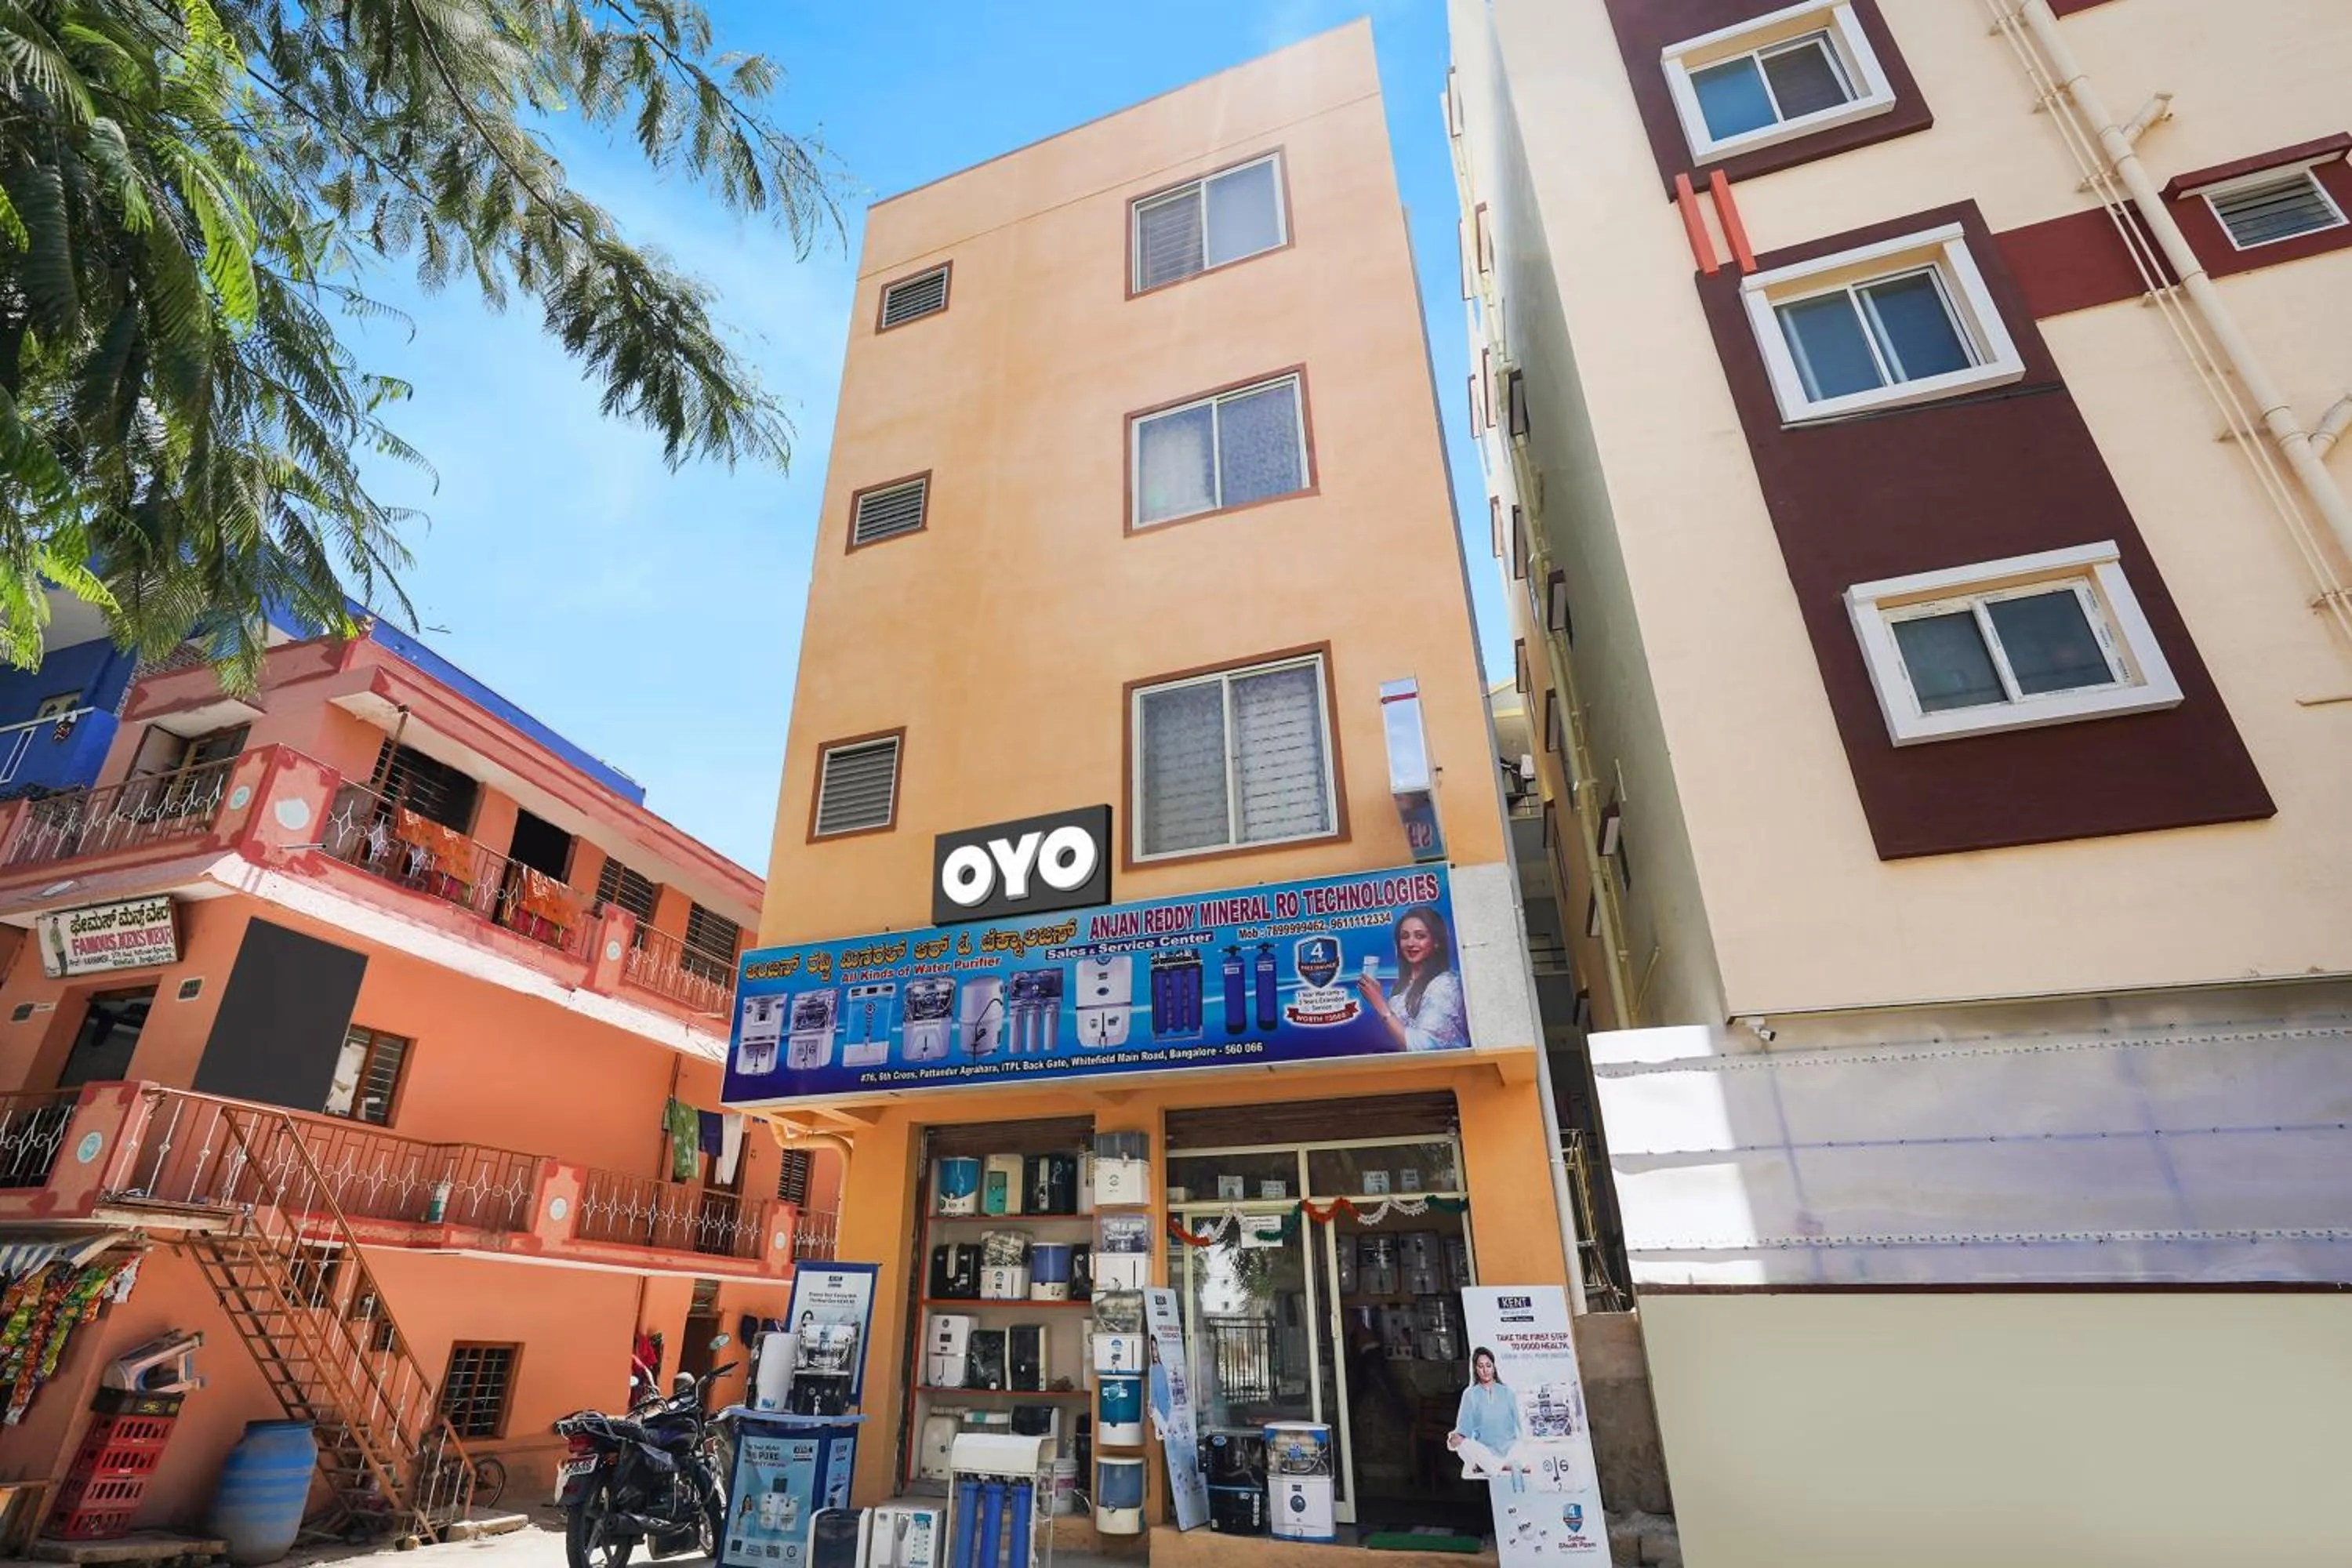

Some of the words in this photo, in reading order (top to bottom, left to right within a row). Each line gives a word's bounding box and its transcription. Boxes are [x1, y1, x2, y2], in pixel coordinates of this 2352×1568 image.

[942, 826, 1098, 907] OYO
[1089, 912, 1140, 941] ANJAN
[1145, 903, 1196, 933] REDDY
[1200, 895, 1271, 927] MINERAL
[1276, 891, 1298, 917] RO
[1303, 874, 1439, 915] TECHNOLOGIES
[71, 932, 117, 956] FAMOUS
[146, 926, 173, 946] WEAR
[1047, 946, 1087, 959] Sales
[1098, 940, 1155, 953] Service
[1160, 932, 1211, 946] Center
[1239, 928, 1258, 939] Mob
[1311, 942, 1323, 958] 4
[842, 971, 856, 983] All
[860, 967, 893, 981] Kinds
[898, 965, 909, 977] of
[914, 962, 951, 975] Water
[953, 956, 1001, 970] Purifier
[1001, 1061, 1021, 1072] ITPL
[1022, 1058, 1044, 1070] Back
[1047, 1057, 1069, 1069] Gate,
[1071, 1054, 1116, 1068] Whitefield
[1117, 1052, 1140, 1063] Main
[1141, 1050, 1167, 1061] Road,
[1170, 1046, 1216, 1060] Bangalore
[1225, 1044, 1242, 1054] 560
[1244, 1042, 1263, 1053] 066
[1498, 1297, 1526, 1308] KENT
